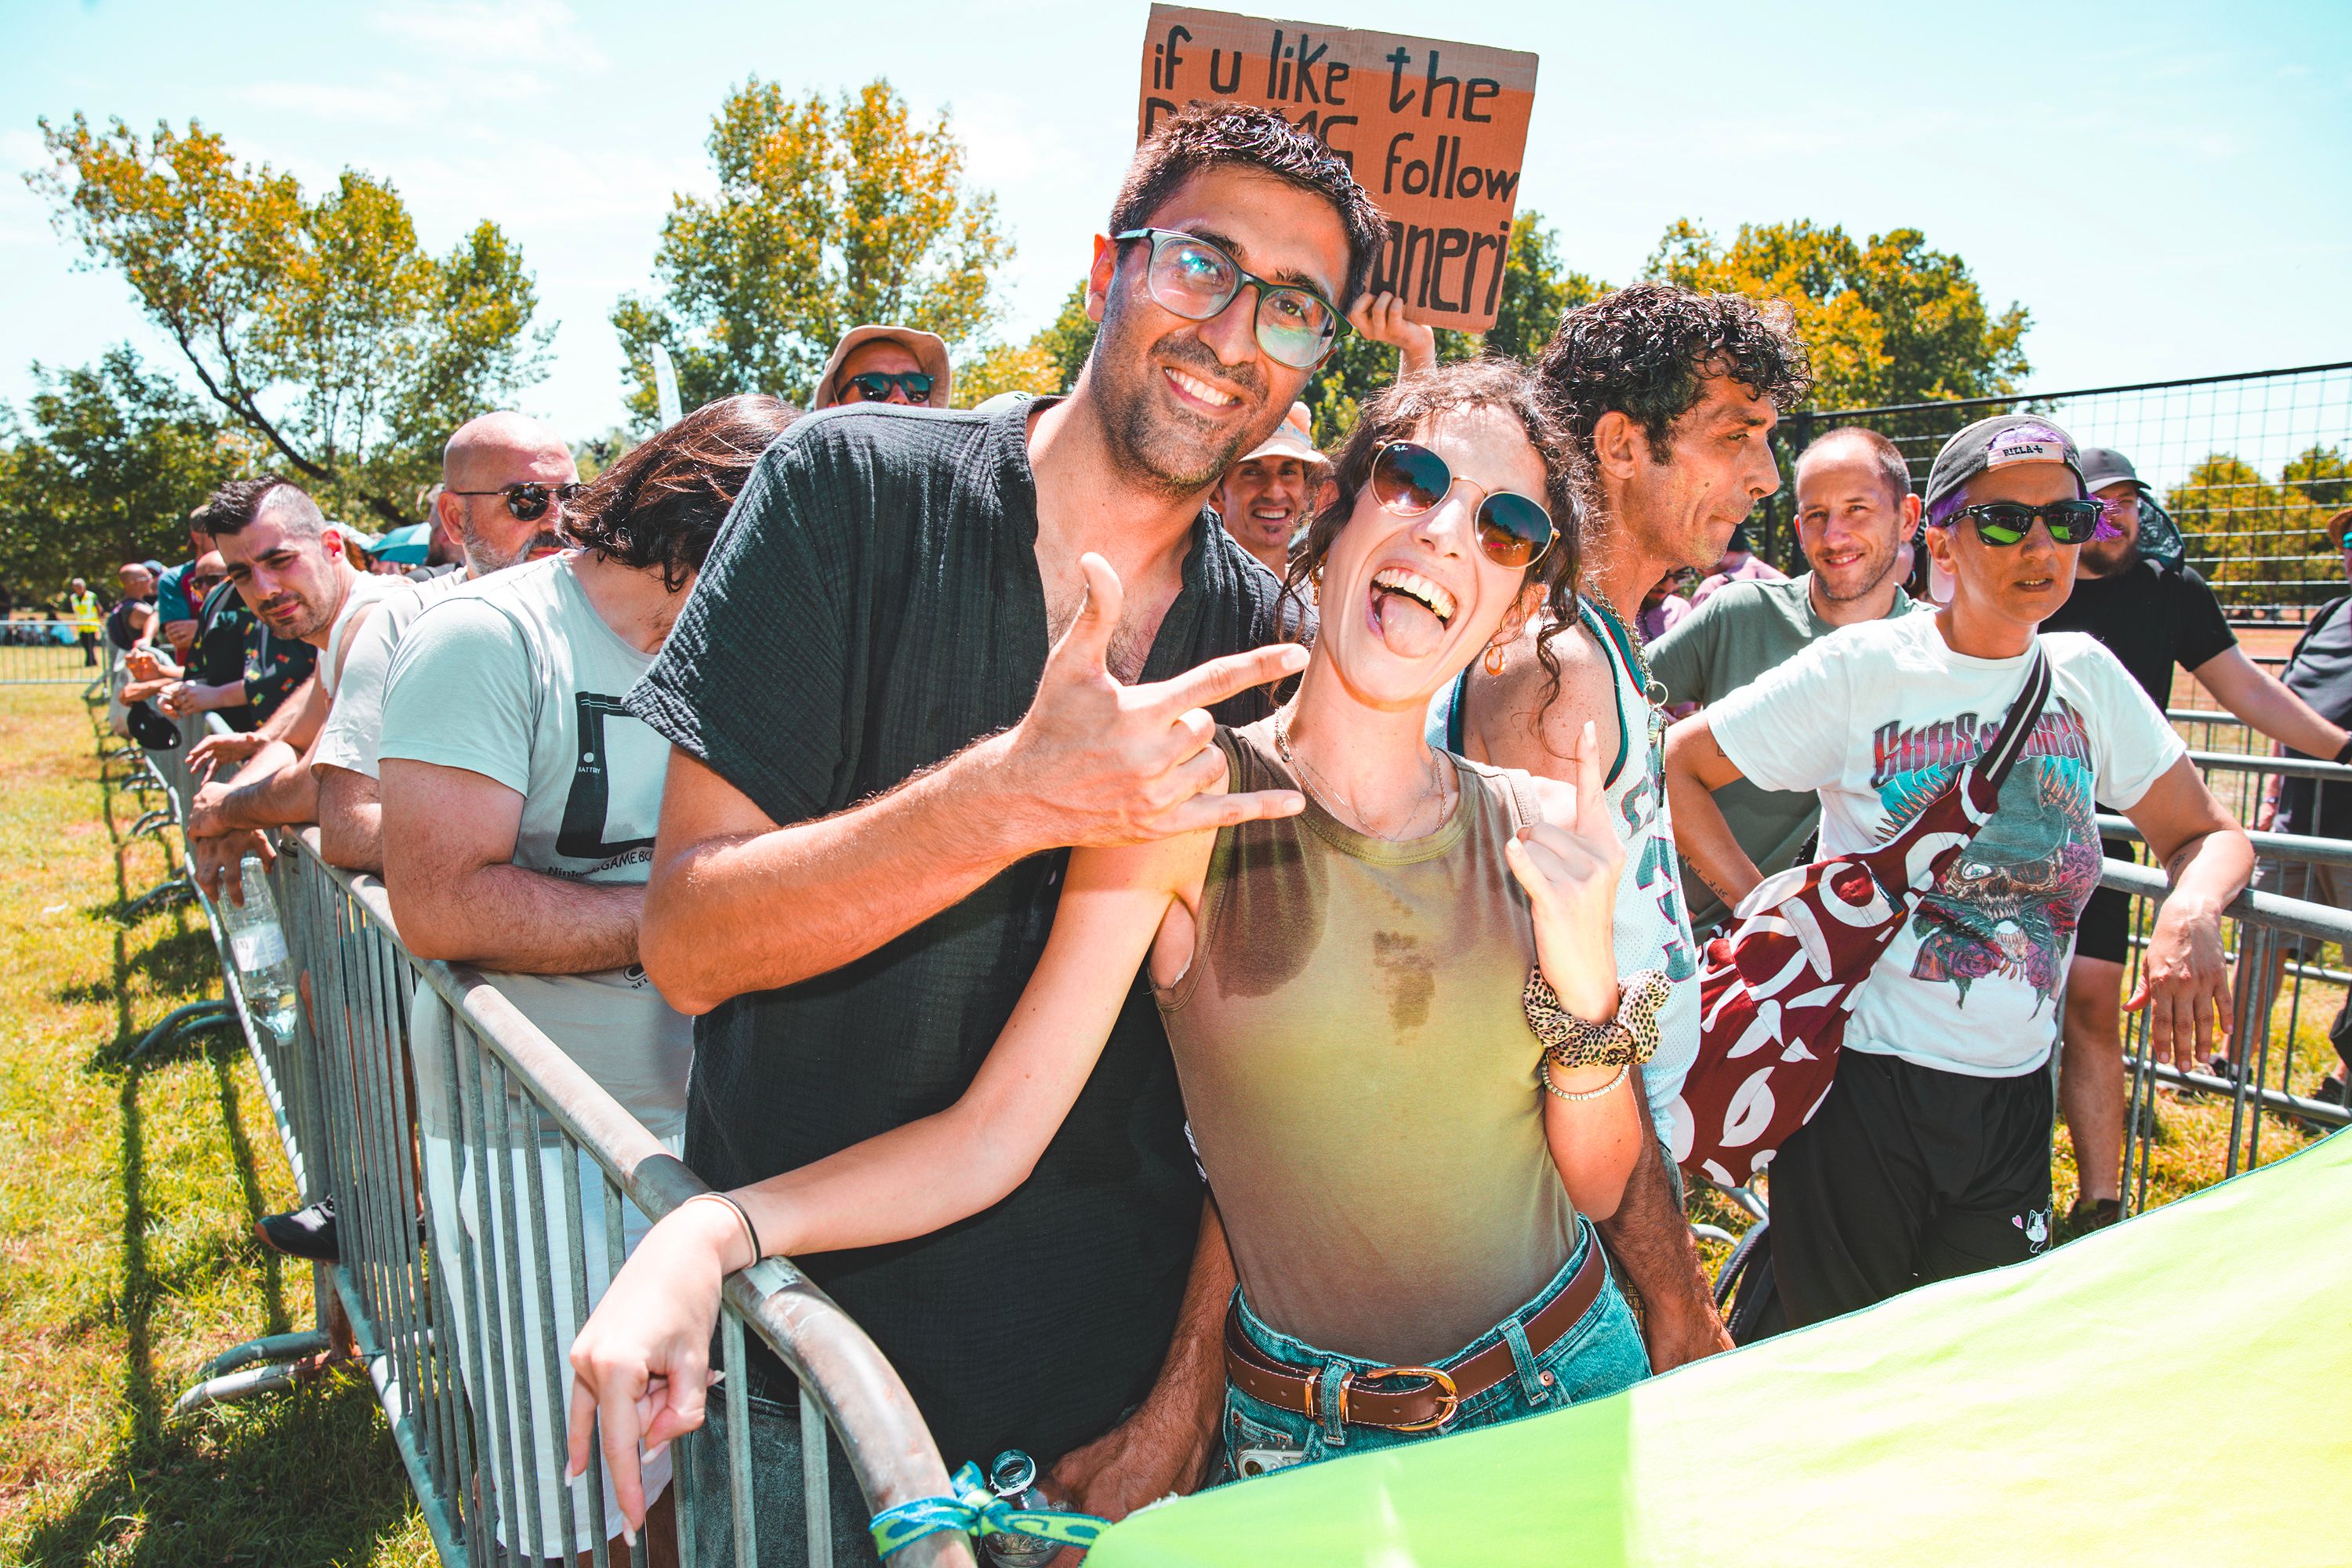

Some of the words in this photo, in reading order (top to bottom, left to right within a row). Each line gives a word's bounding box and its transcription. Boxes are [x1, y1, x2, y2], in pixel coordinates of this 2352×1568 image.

[1154, 25, 1192, 90] if
[1210, 49, 1242, 93] u
[1386, 46, 1501, 123] the
[1383, 132, 1520, 203] follow
[601, 851, 638, 871] GAME
[638, 851, 653, 862] BO
